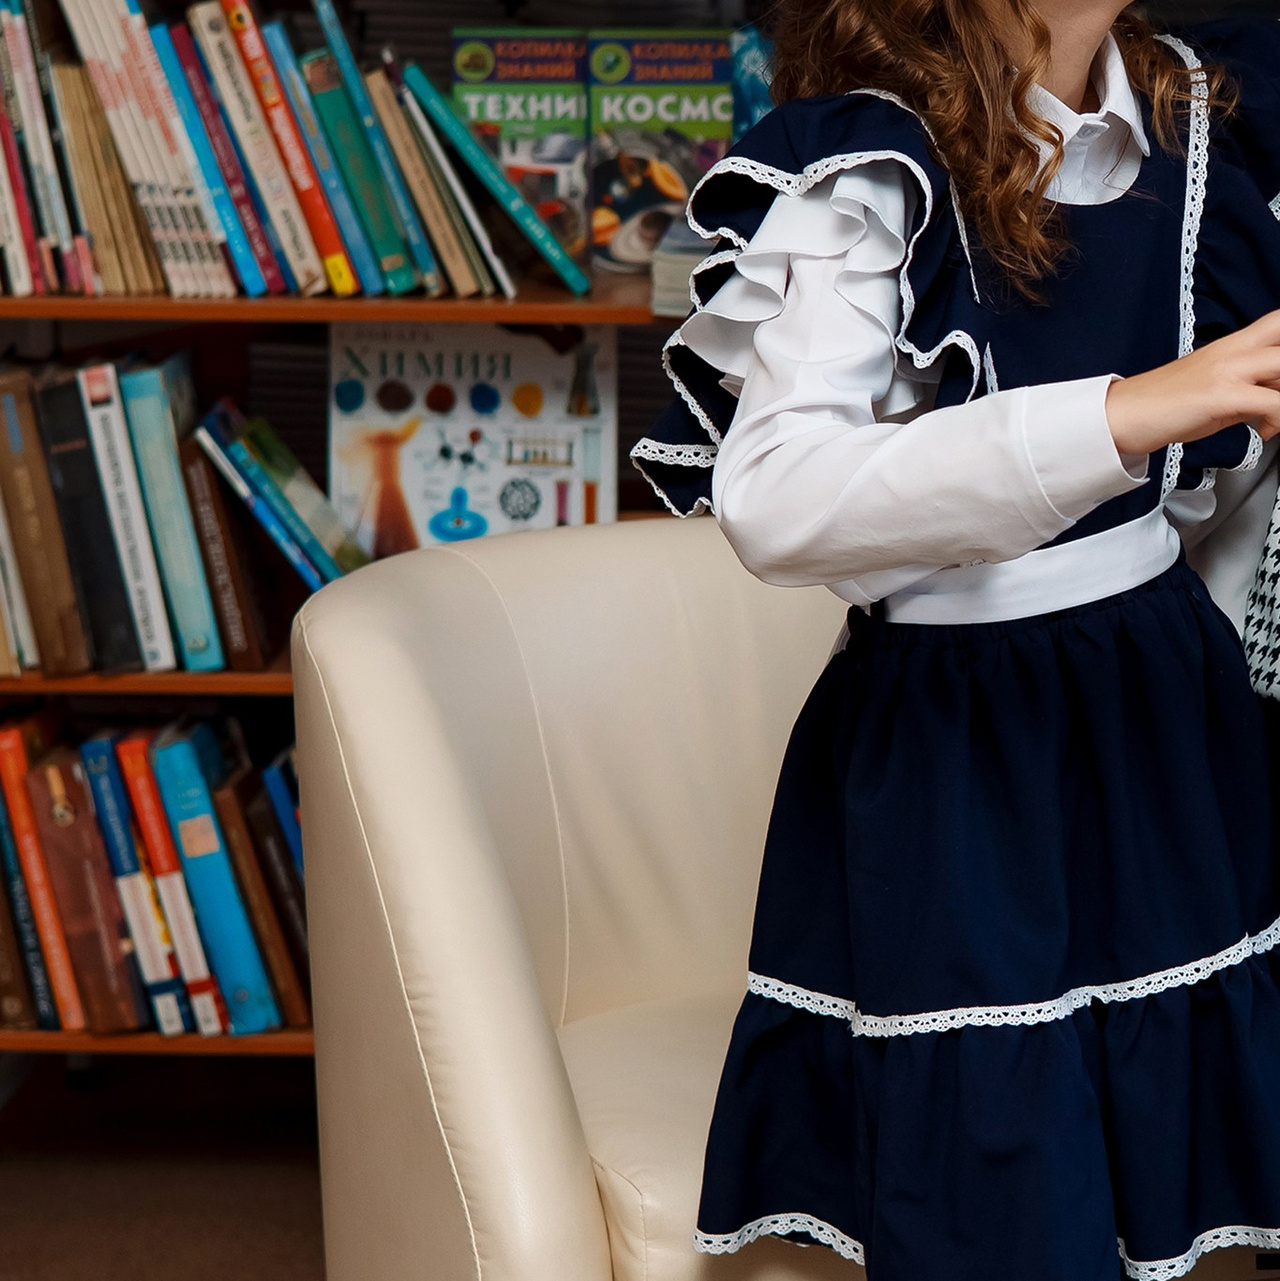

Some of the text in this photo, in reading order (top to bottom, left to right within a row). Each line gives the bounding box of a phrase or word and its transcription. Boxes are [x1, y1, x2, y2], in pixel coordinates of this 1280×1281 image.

[632, 43, 729, 59] КОПИЛКА
[634, 62, 713, 80] ЗНАНИЙ
[345, 346, 512, 379] ХИМИЯ
